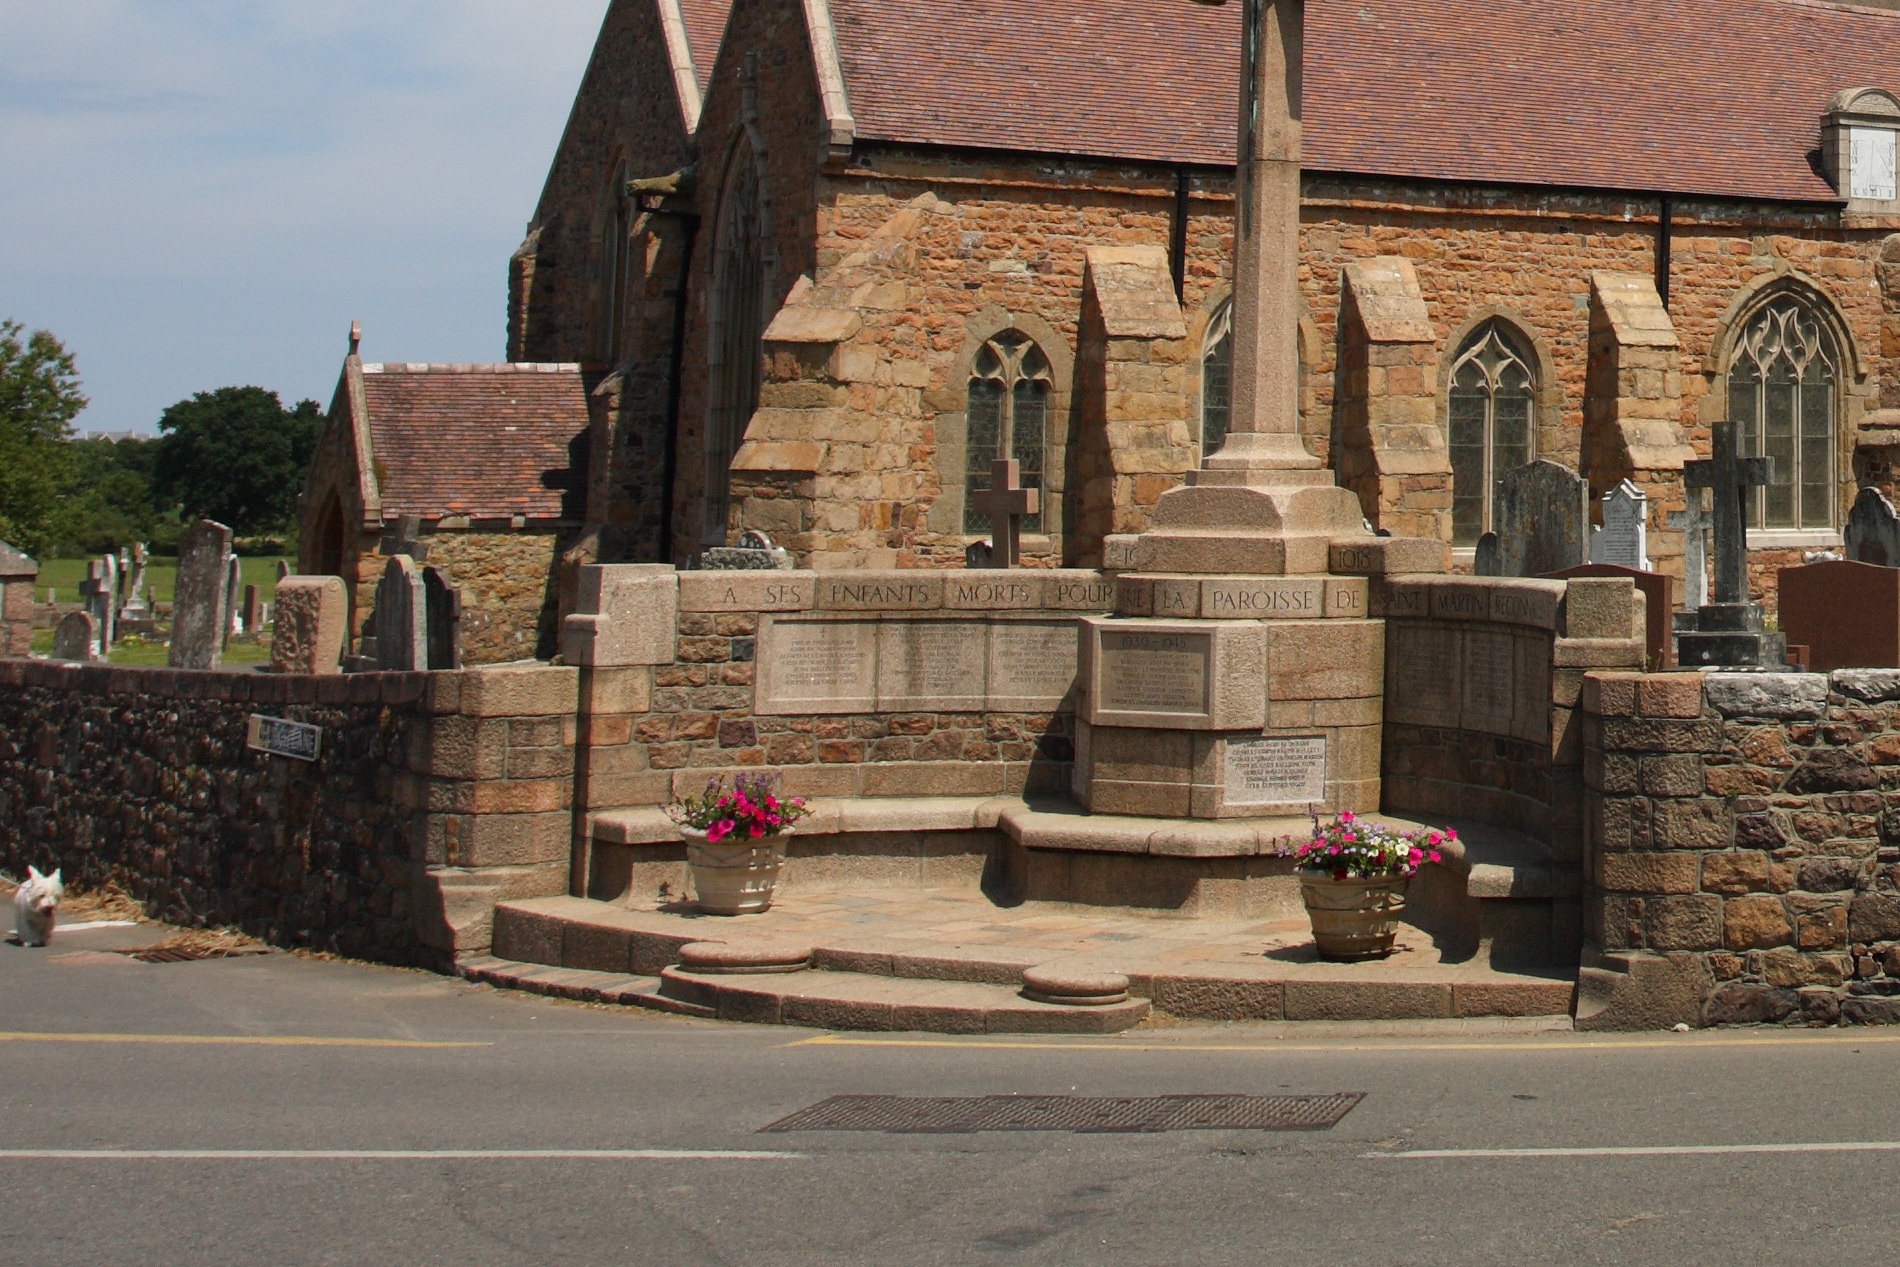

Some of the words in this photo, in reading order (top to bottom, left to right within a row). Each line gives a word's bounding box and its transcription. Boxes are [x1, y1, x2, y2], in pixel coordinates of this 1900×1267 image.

[722, 586, 738, 604] A
[766, 585, 800, 604] SES
[831, 584, 929, 603] ENFANTS
[957, 584, 1030, 603] MORTS
[1057, 583, 1112, 603] POUR
[1163, 590, 1186, 610] LA
[1212, 589, 1313, 611] PAROISSE
[1336, 589, 1360, 609] DE
[1379, 590, 1421, 611] SAINT
[1438, 593, 1483, 613] MARTIN
